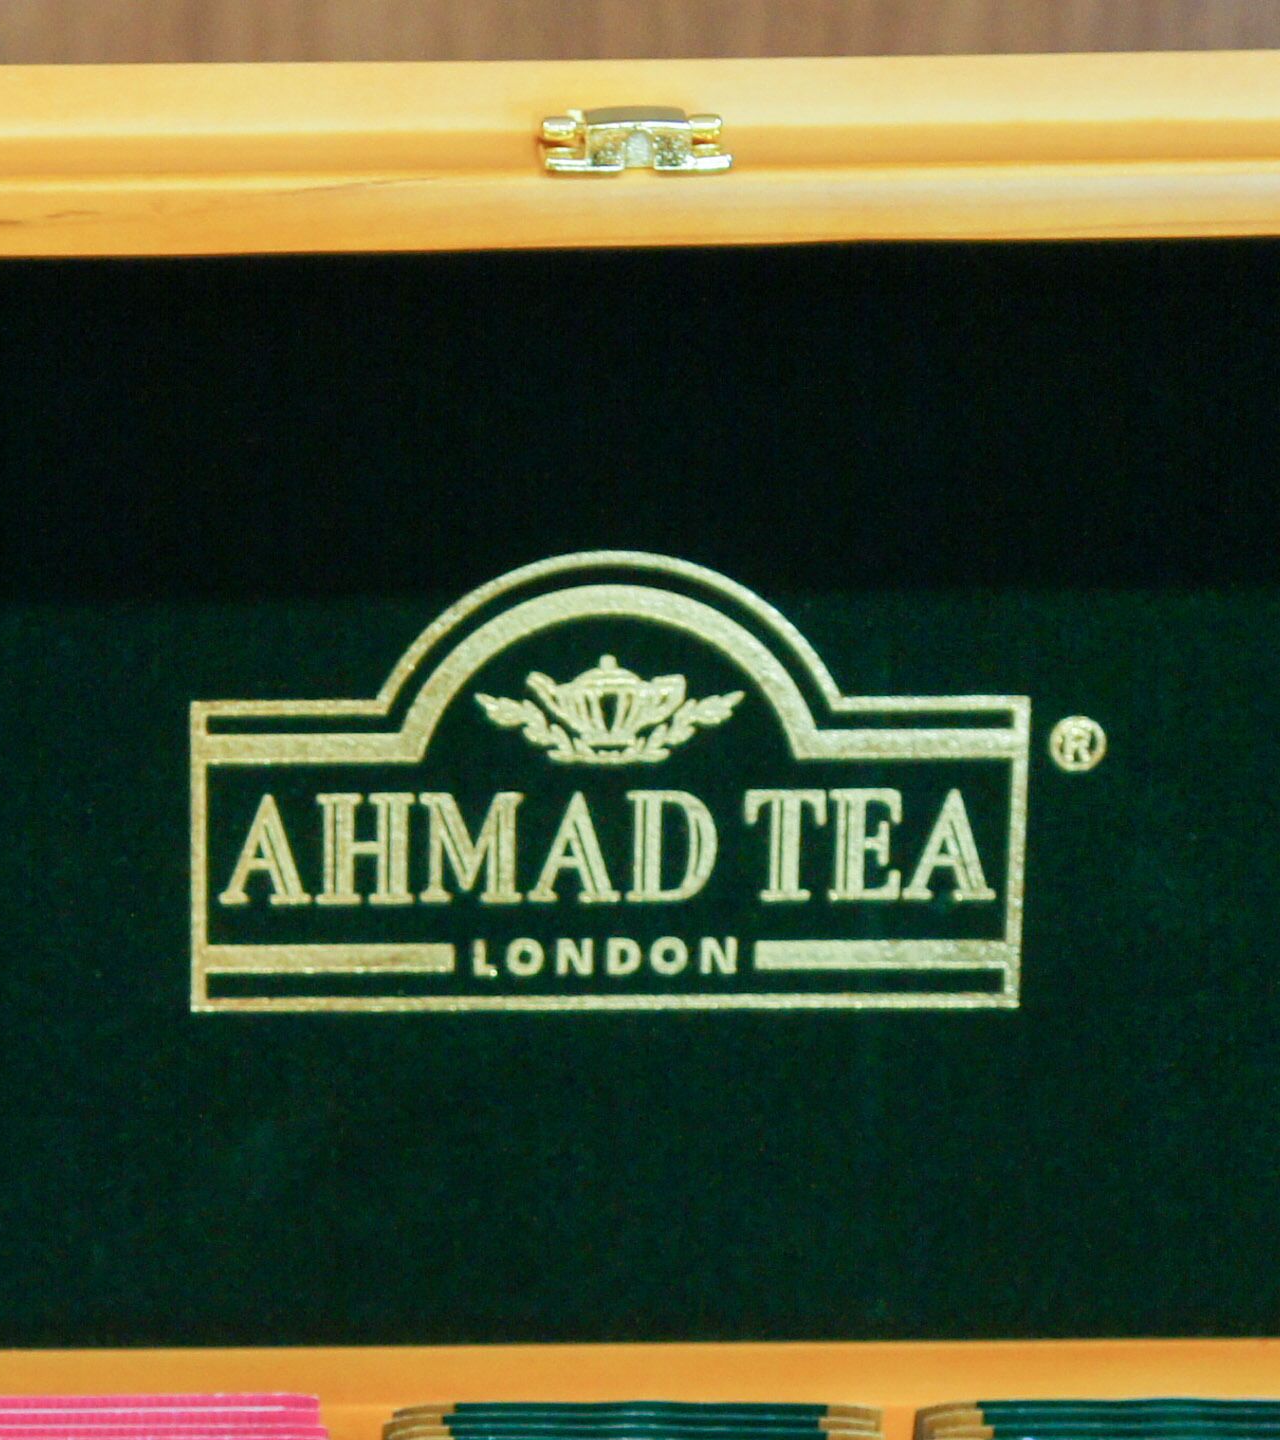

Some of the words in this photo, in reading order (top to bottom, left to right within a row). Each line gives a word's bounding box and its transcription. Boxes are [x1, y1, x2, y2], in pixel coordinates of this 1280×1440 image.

[219, 790, 717, 905] AHMAD
[744, 787, 996, 903] TEA
[472, 936, 738, 977] LONDON
